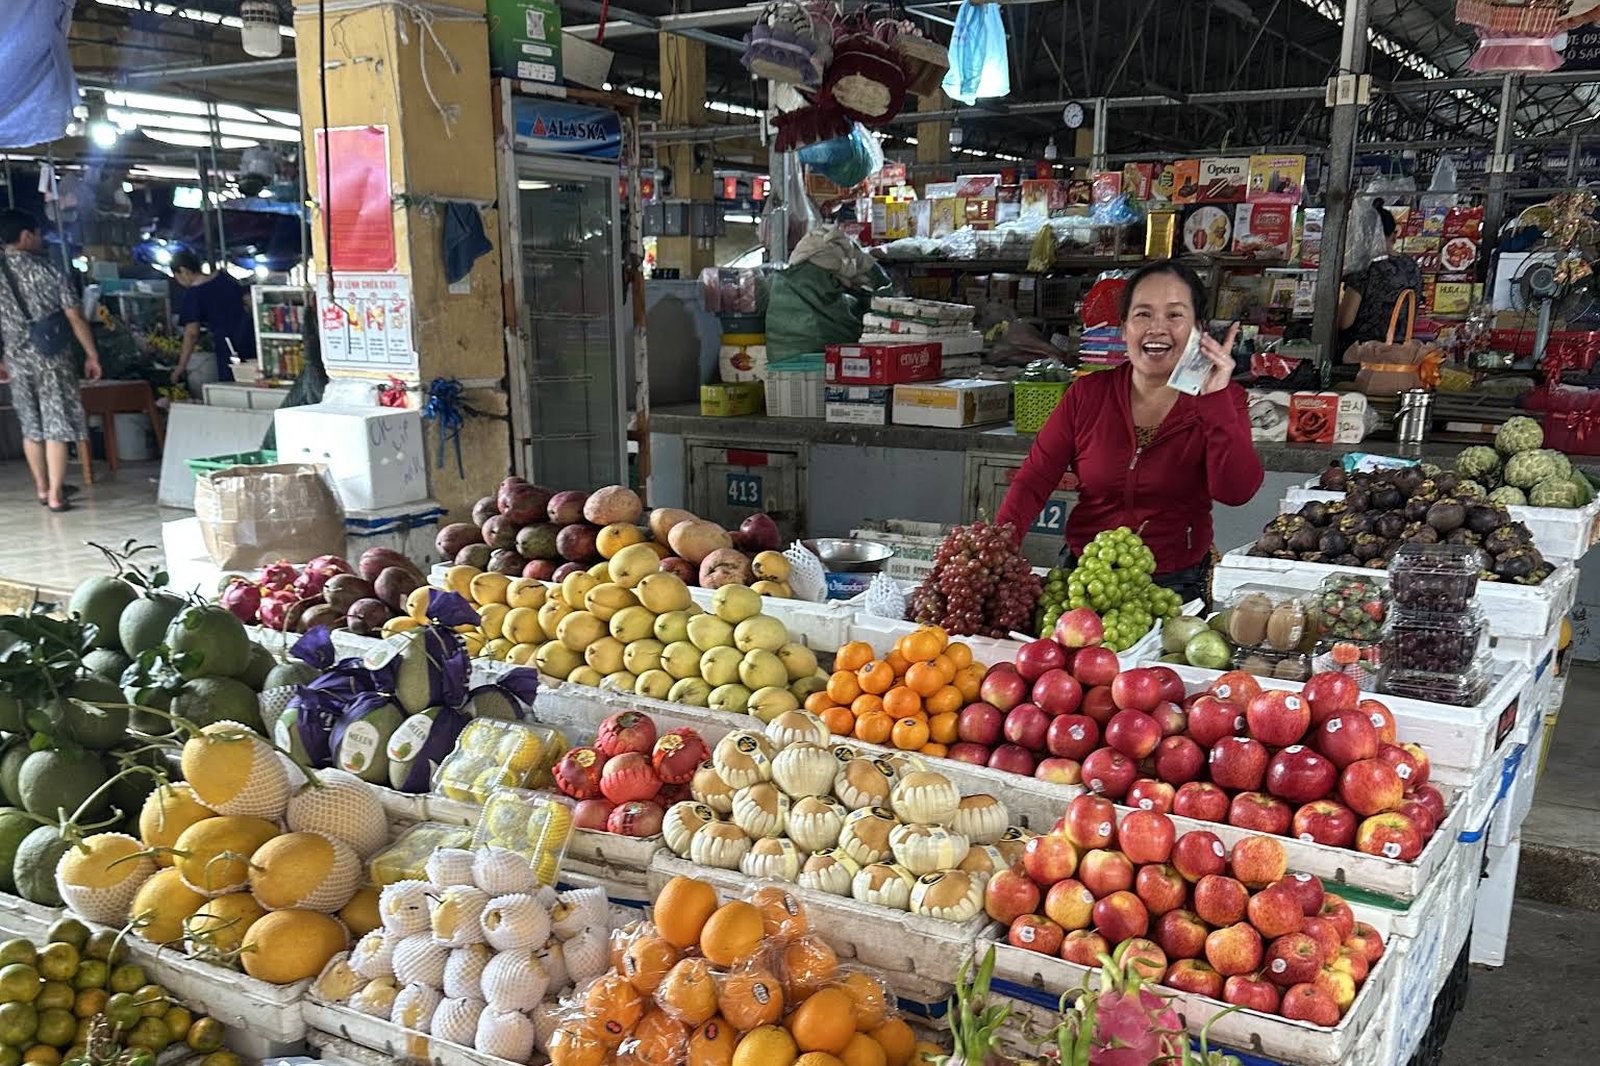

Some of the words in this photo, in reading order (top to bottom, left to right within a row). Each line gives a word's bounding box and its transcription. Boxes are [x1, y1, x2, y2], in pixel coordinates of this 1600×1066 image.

[548, 119, 607, 141] ALASKA
[1207, 163, 1240, 176] Opéra
[728, 479, 758, 502] 413
[1035, 505, 1062, 529] 12
